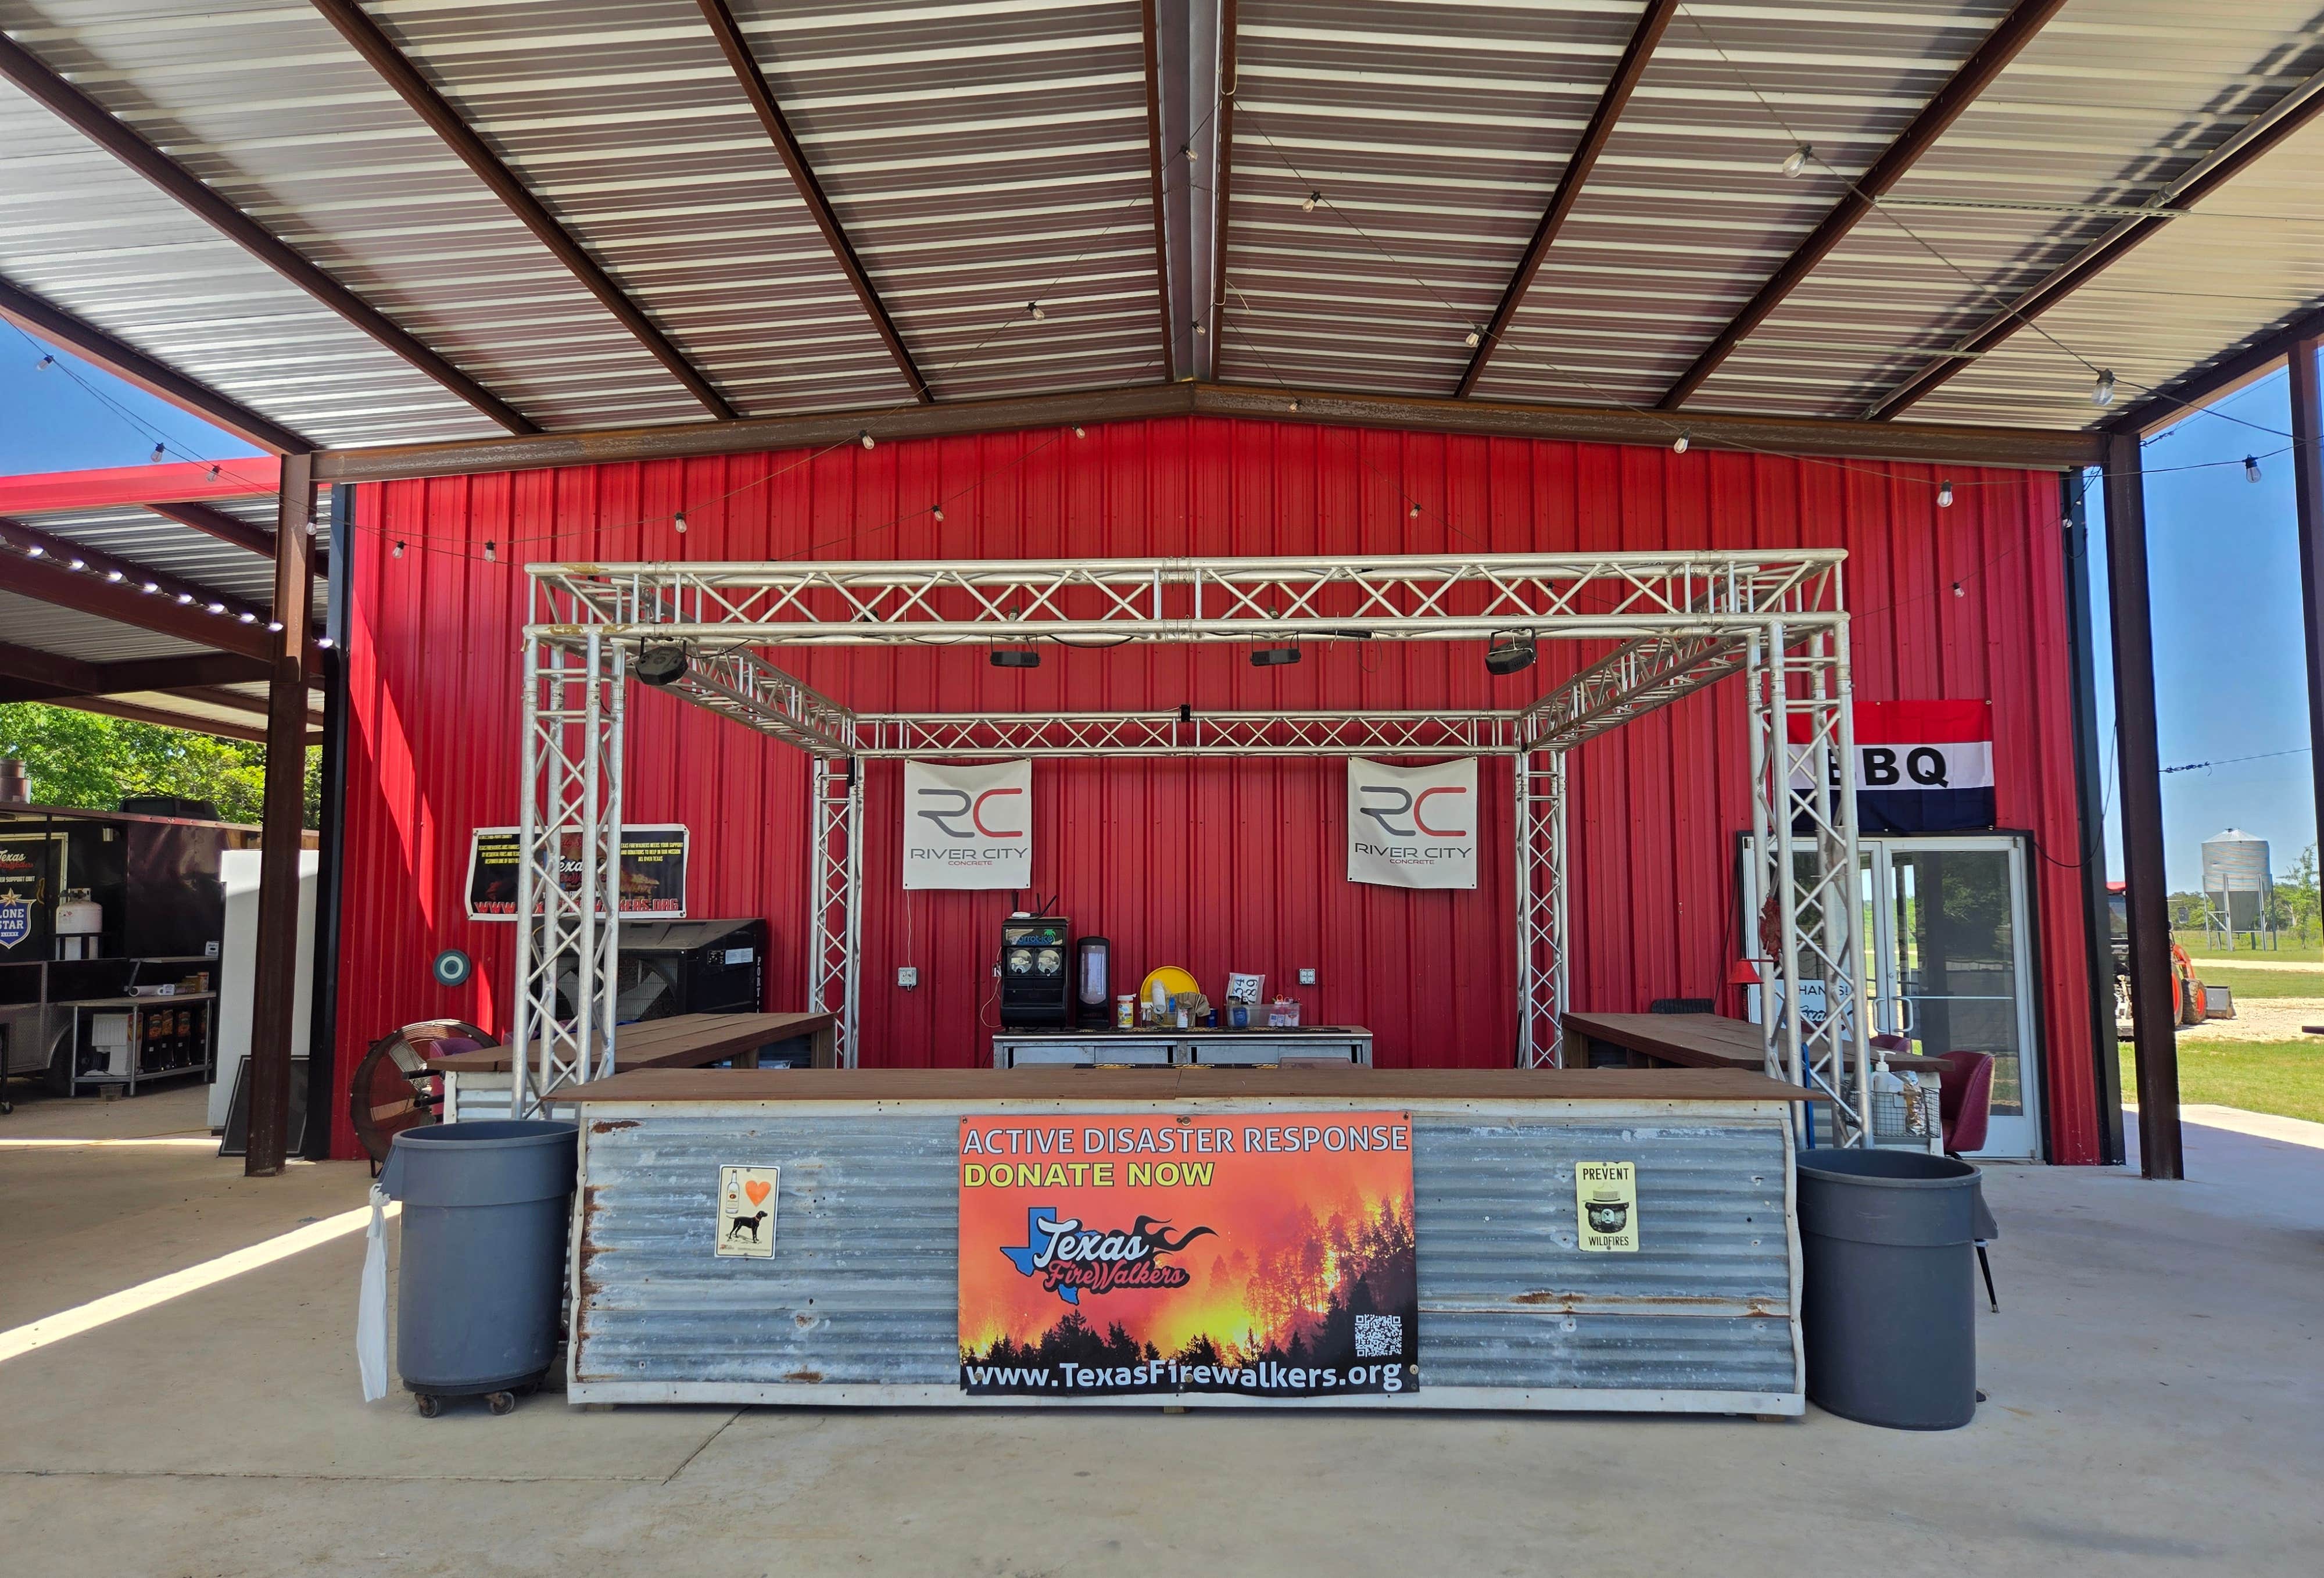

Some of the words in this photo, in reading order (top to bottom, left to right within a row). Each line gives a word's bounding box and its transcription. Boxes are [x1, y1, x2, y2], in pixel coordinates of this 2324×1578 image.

[918, 788, 1023, 838] RC
[1360, 786, 1467, 836] RC
[911, 849, 976, 859] RIVER
[983, 848, 1028, 858] CITY
[1355, 843, 1418, 858] RIVER
[1424, 847, 1471, 858] CITY
[962, 1128, 1074, 1154] ACTIVE
[1083, 1128, 1236, 1154] DISASTER
[1244, 1125, 1408, 1153] RESPONSE
[964, 1163, 1114, 1187] DONATE
[1127, 1162, 1215, 1186] NOW
[1583, 1168, 1629, 1180] PREVENT
[1033, 1216, 1149, 1268] Texas
[1588, 1236, 1629, 1246] WILDFIRES
[1045, 1260, 1186, 1290] FireWalkers
[966, 1359, 1402, 1392] www.TexasFirewalkers.org
